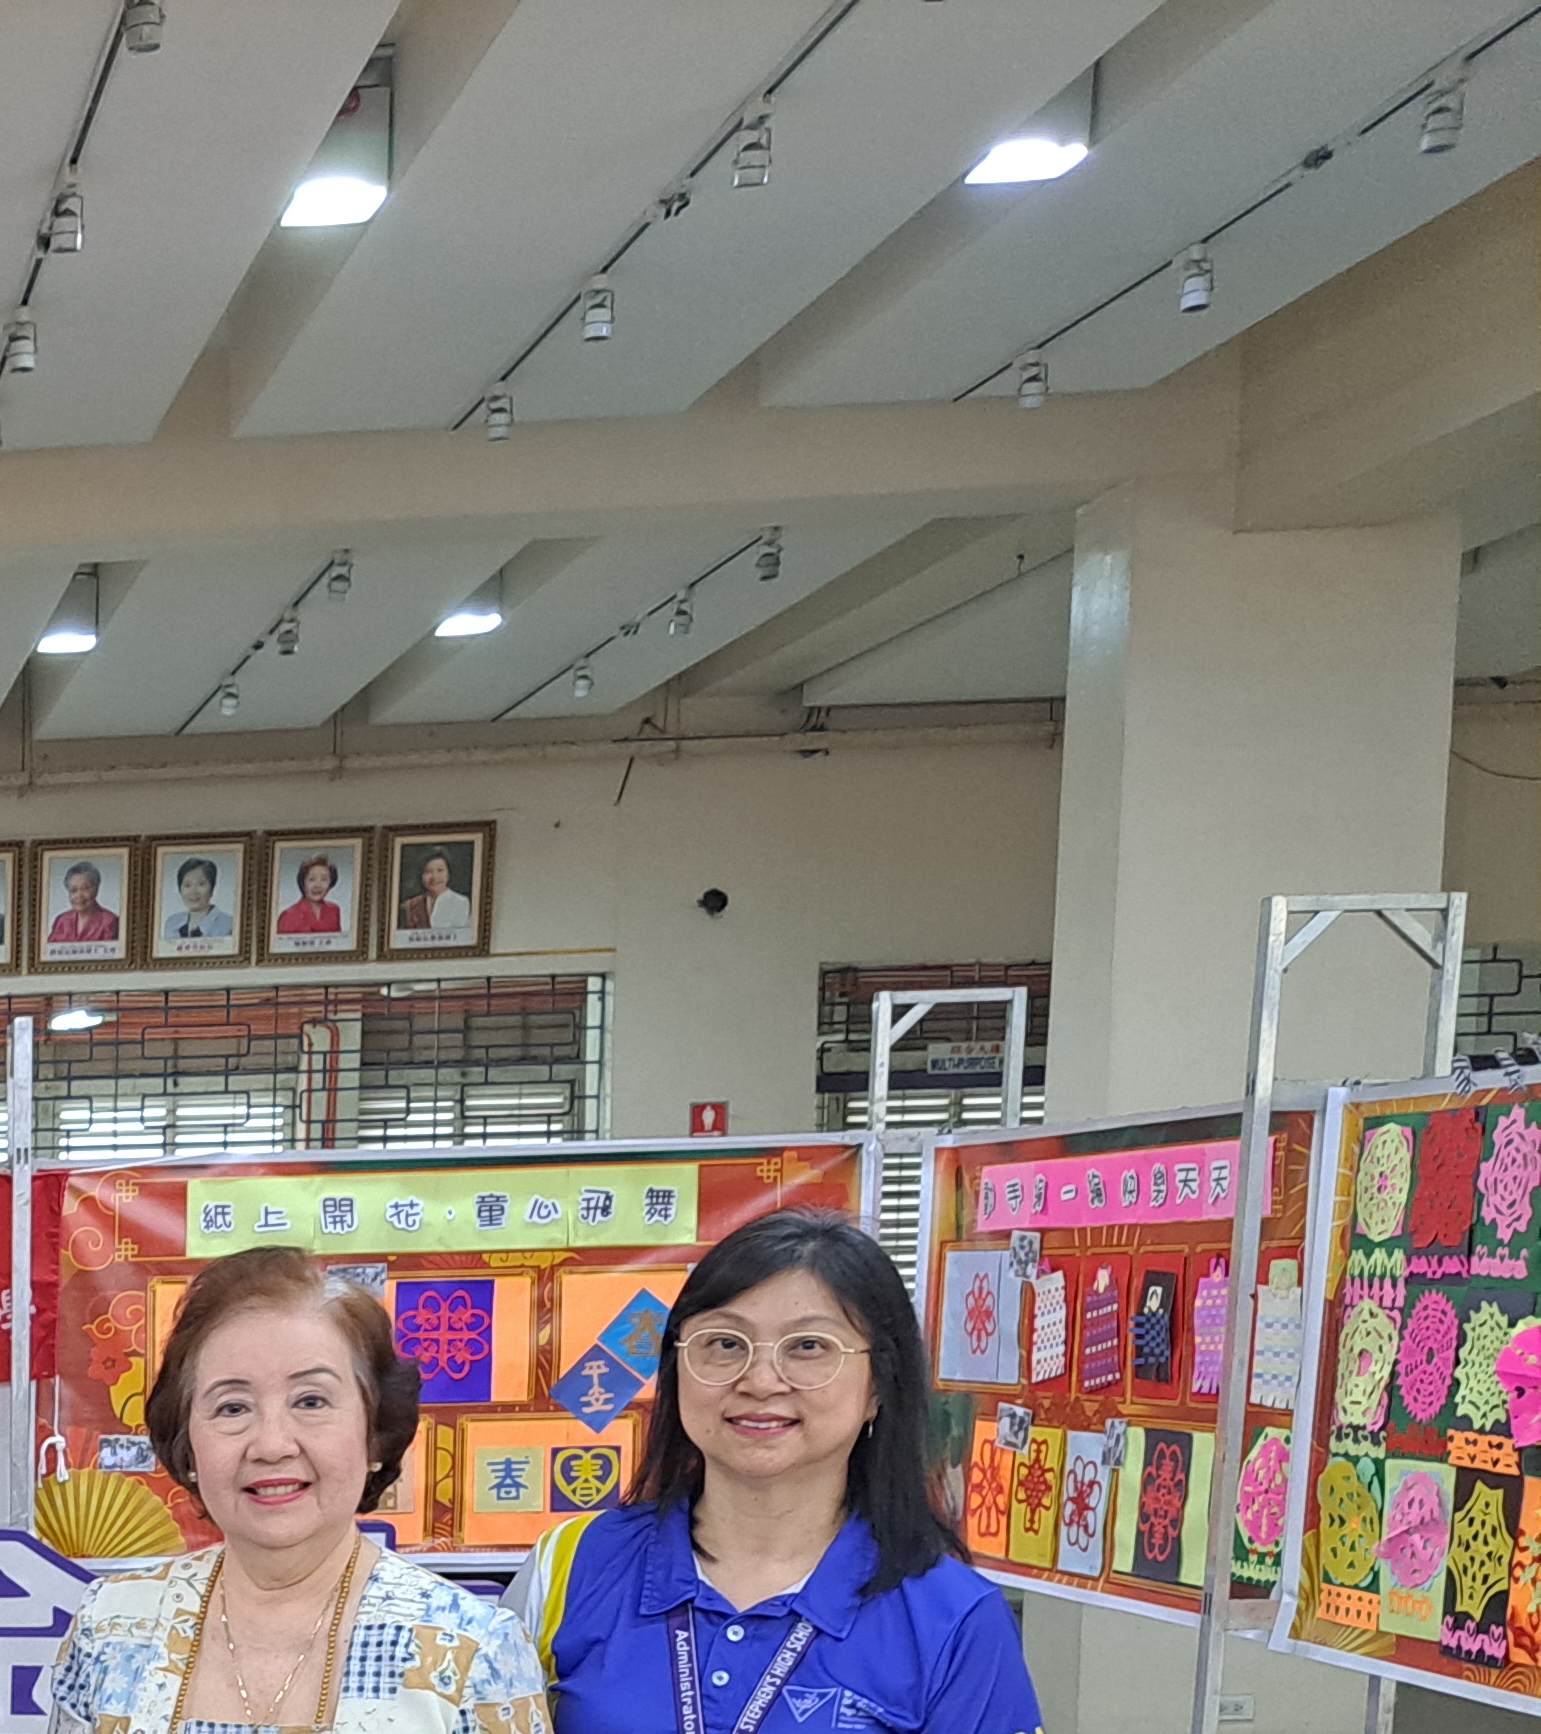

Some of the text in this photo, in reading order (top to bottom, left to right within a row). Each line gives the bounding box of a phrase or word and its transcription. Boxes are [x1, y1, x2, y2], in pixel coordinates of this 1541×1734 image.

[485, 1457, 532, 1502] 春
[739, 1675, 781, 1733] STEPHEN'S
[770, 1649, 797, 1678] HIGH
